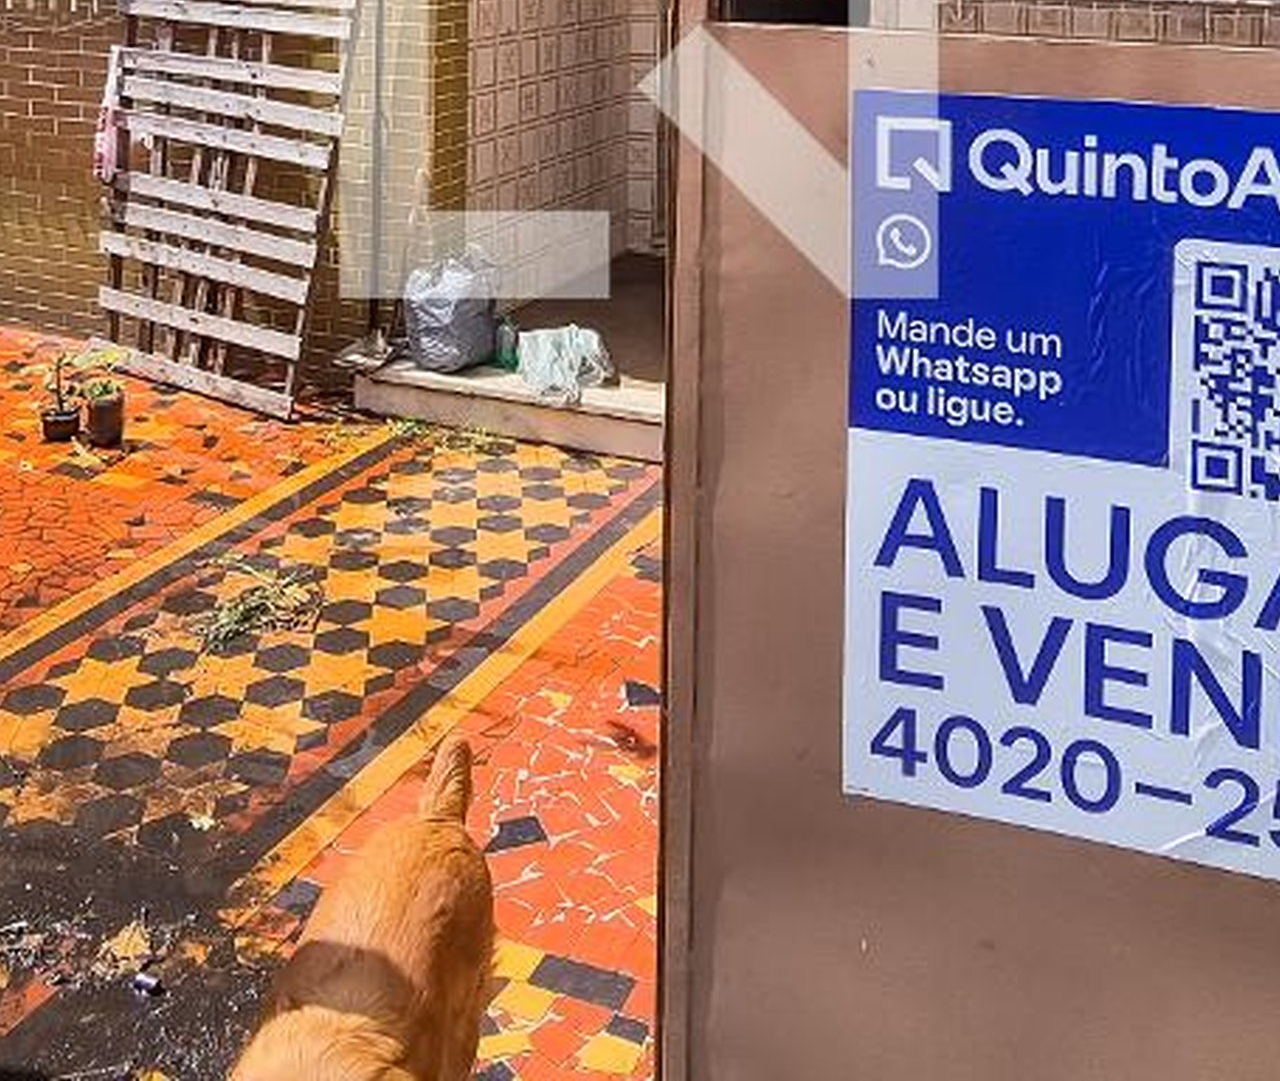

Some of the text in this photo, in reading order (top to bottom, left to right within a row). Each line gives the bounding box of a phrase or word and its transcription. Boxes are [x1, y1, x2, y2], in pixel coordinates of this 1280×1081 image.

[877, 308, 1062, 359] Mande um
[875, 344, 1063, 401] Whatsapp
[875, 385, 1024, 427] ou ligue.
[879, 589, 945, 691] E
